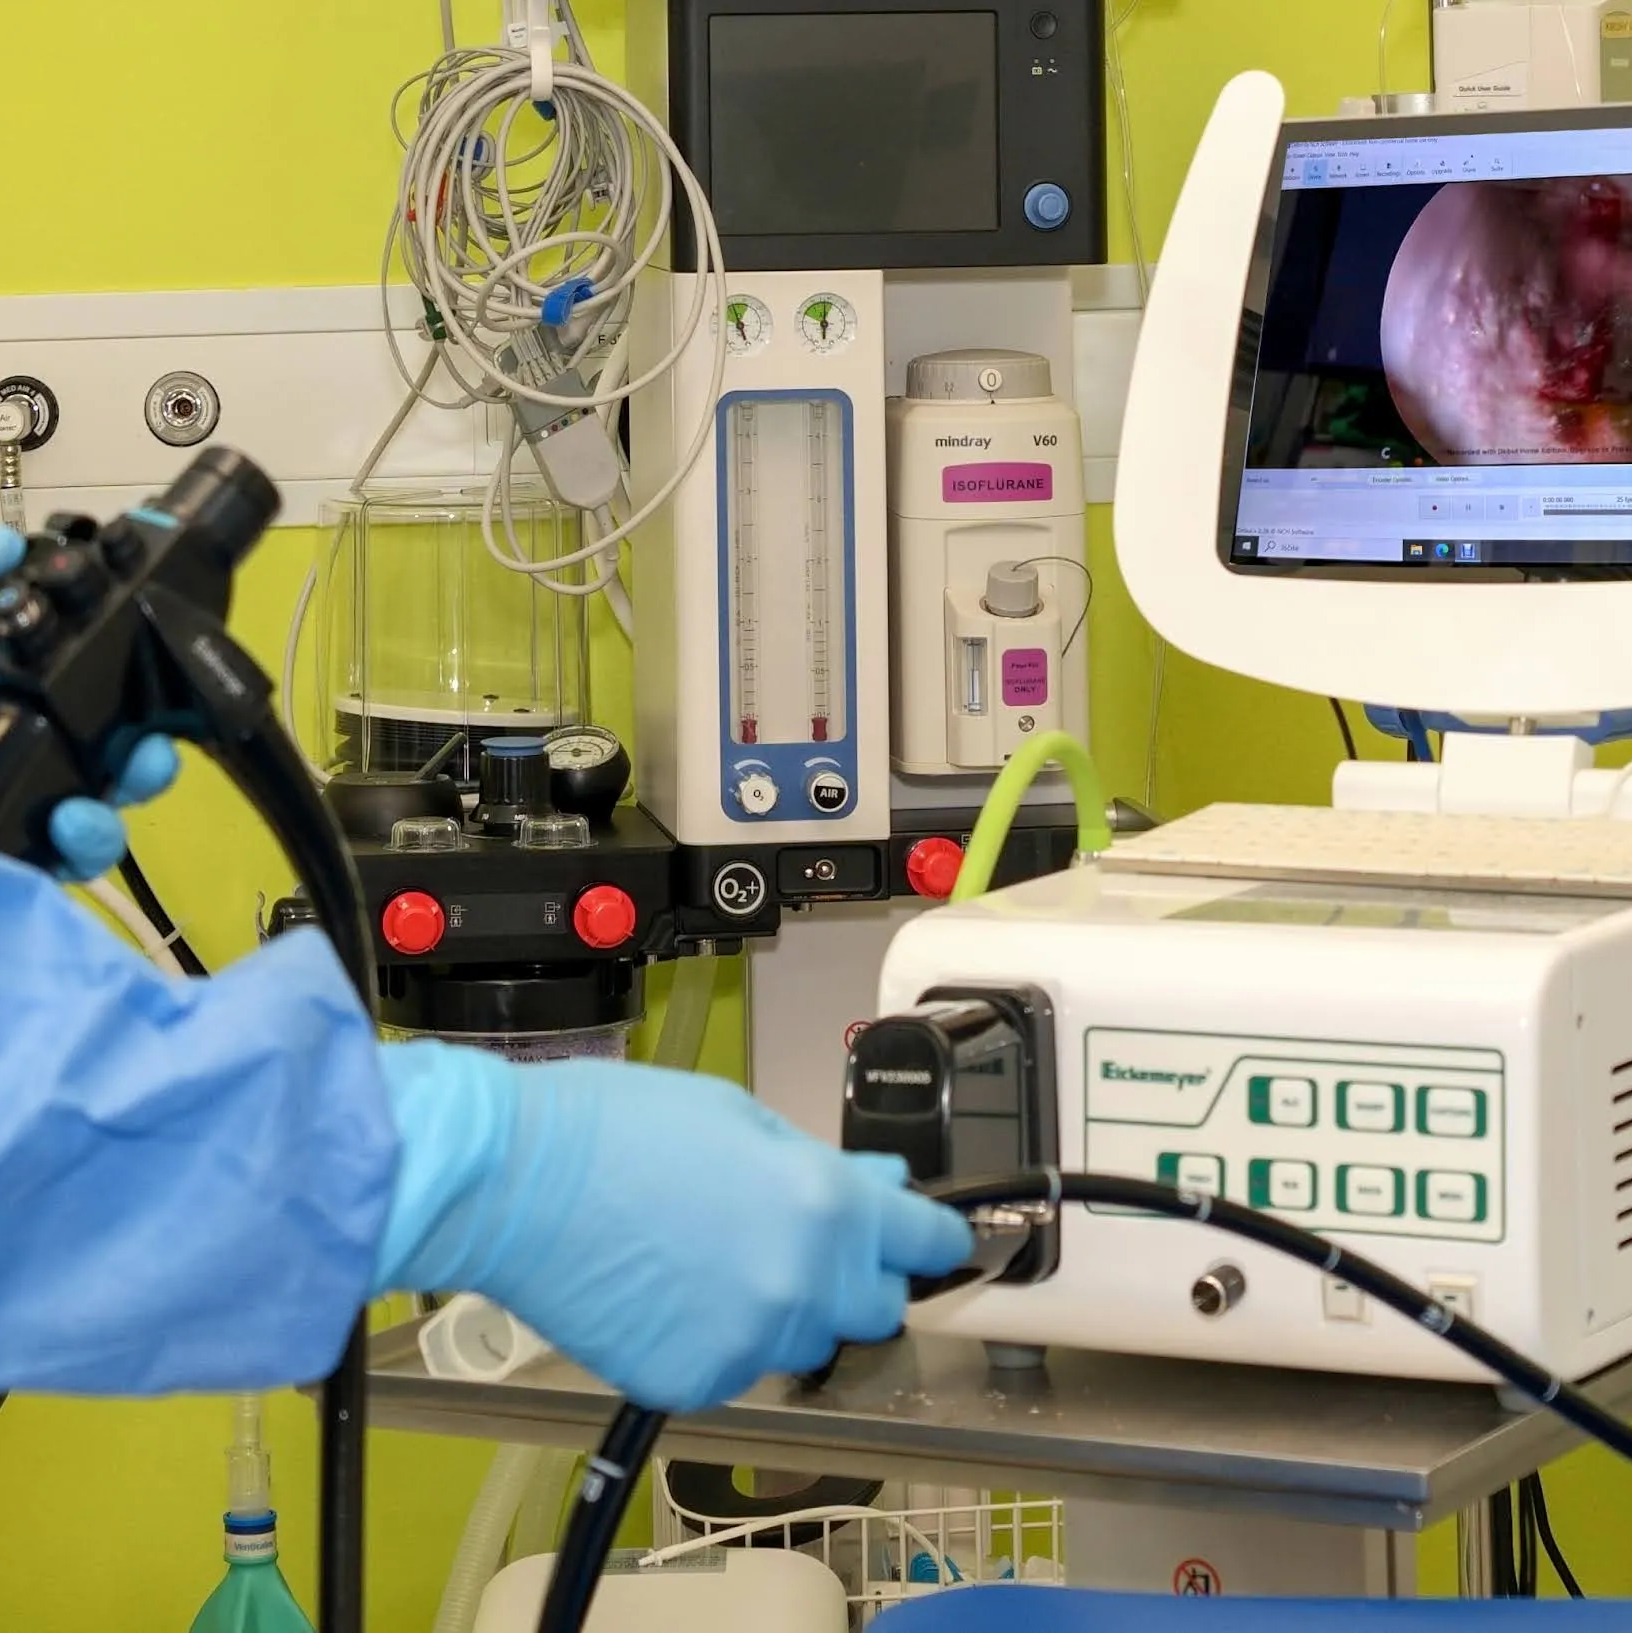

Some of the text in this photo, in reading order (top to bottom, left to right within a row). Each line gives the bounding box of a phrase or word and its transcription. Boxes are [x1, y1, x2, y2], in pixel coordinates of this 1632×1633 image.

[1458, 85, 1476, 93] Quick
[935, 435, 992, 450] mindray
[1033, 435, 1058, 447] V60
[952, 478, 1045, 492] ISOFLURANE
[819, 788, 839, 799] AIR
[518, 1055, 543, 1064] MAX
[1102, 1062, 1206, 1090] Eickemeyer
